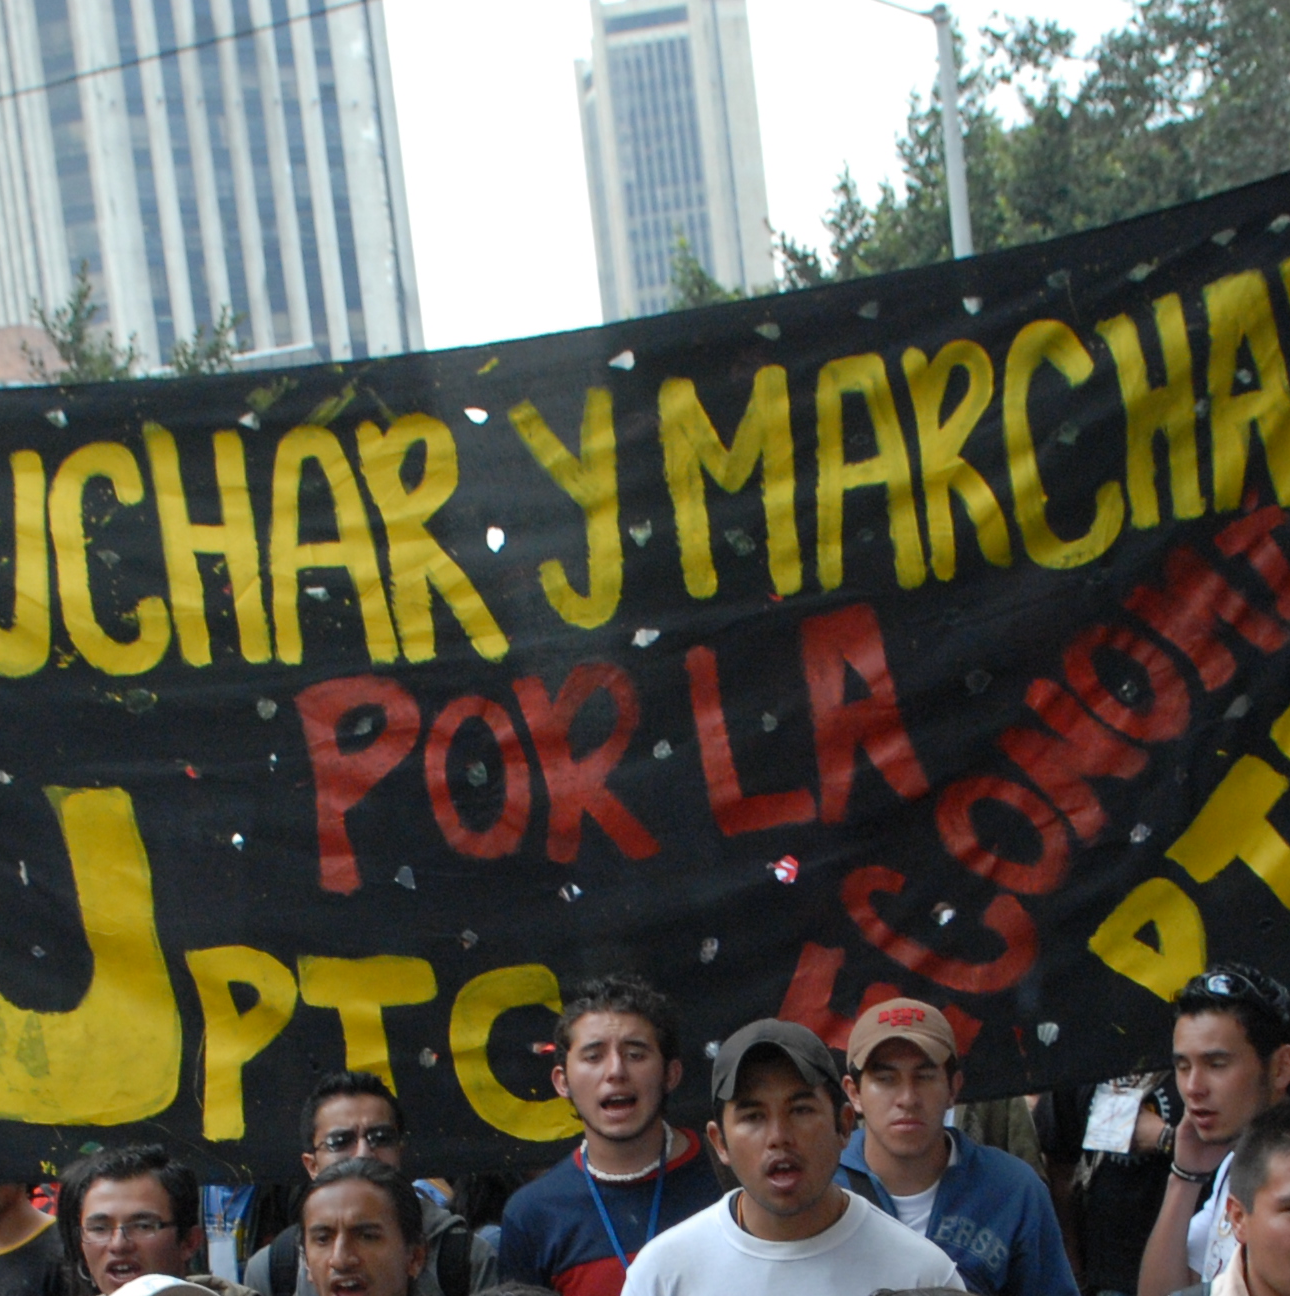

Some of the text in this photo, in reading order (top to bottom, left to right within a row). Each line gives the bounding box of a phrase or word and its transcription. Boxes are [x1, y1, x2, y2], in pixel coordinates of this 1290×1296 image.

[510, 388, 625, 630] Y
[295, 603, 929, 895] POR LA
